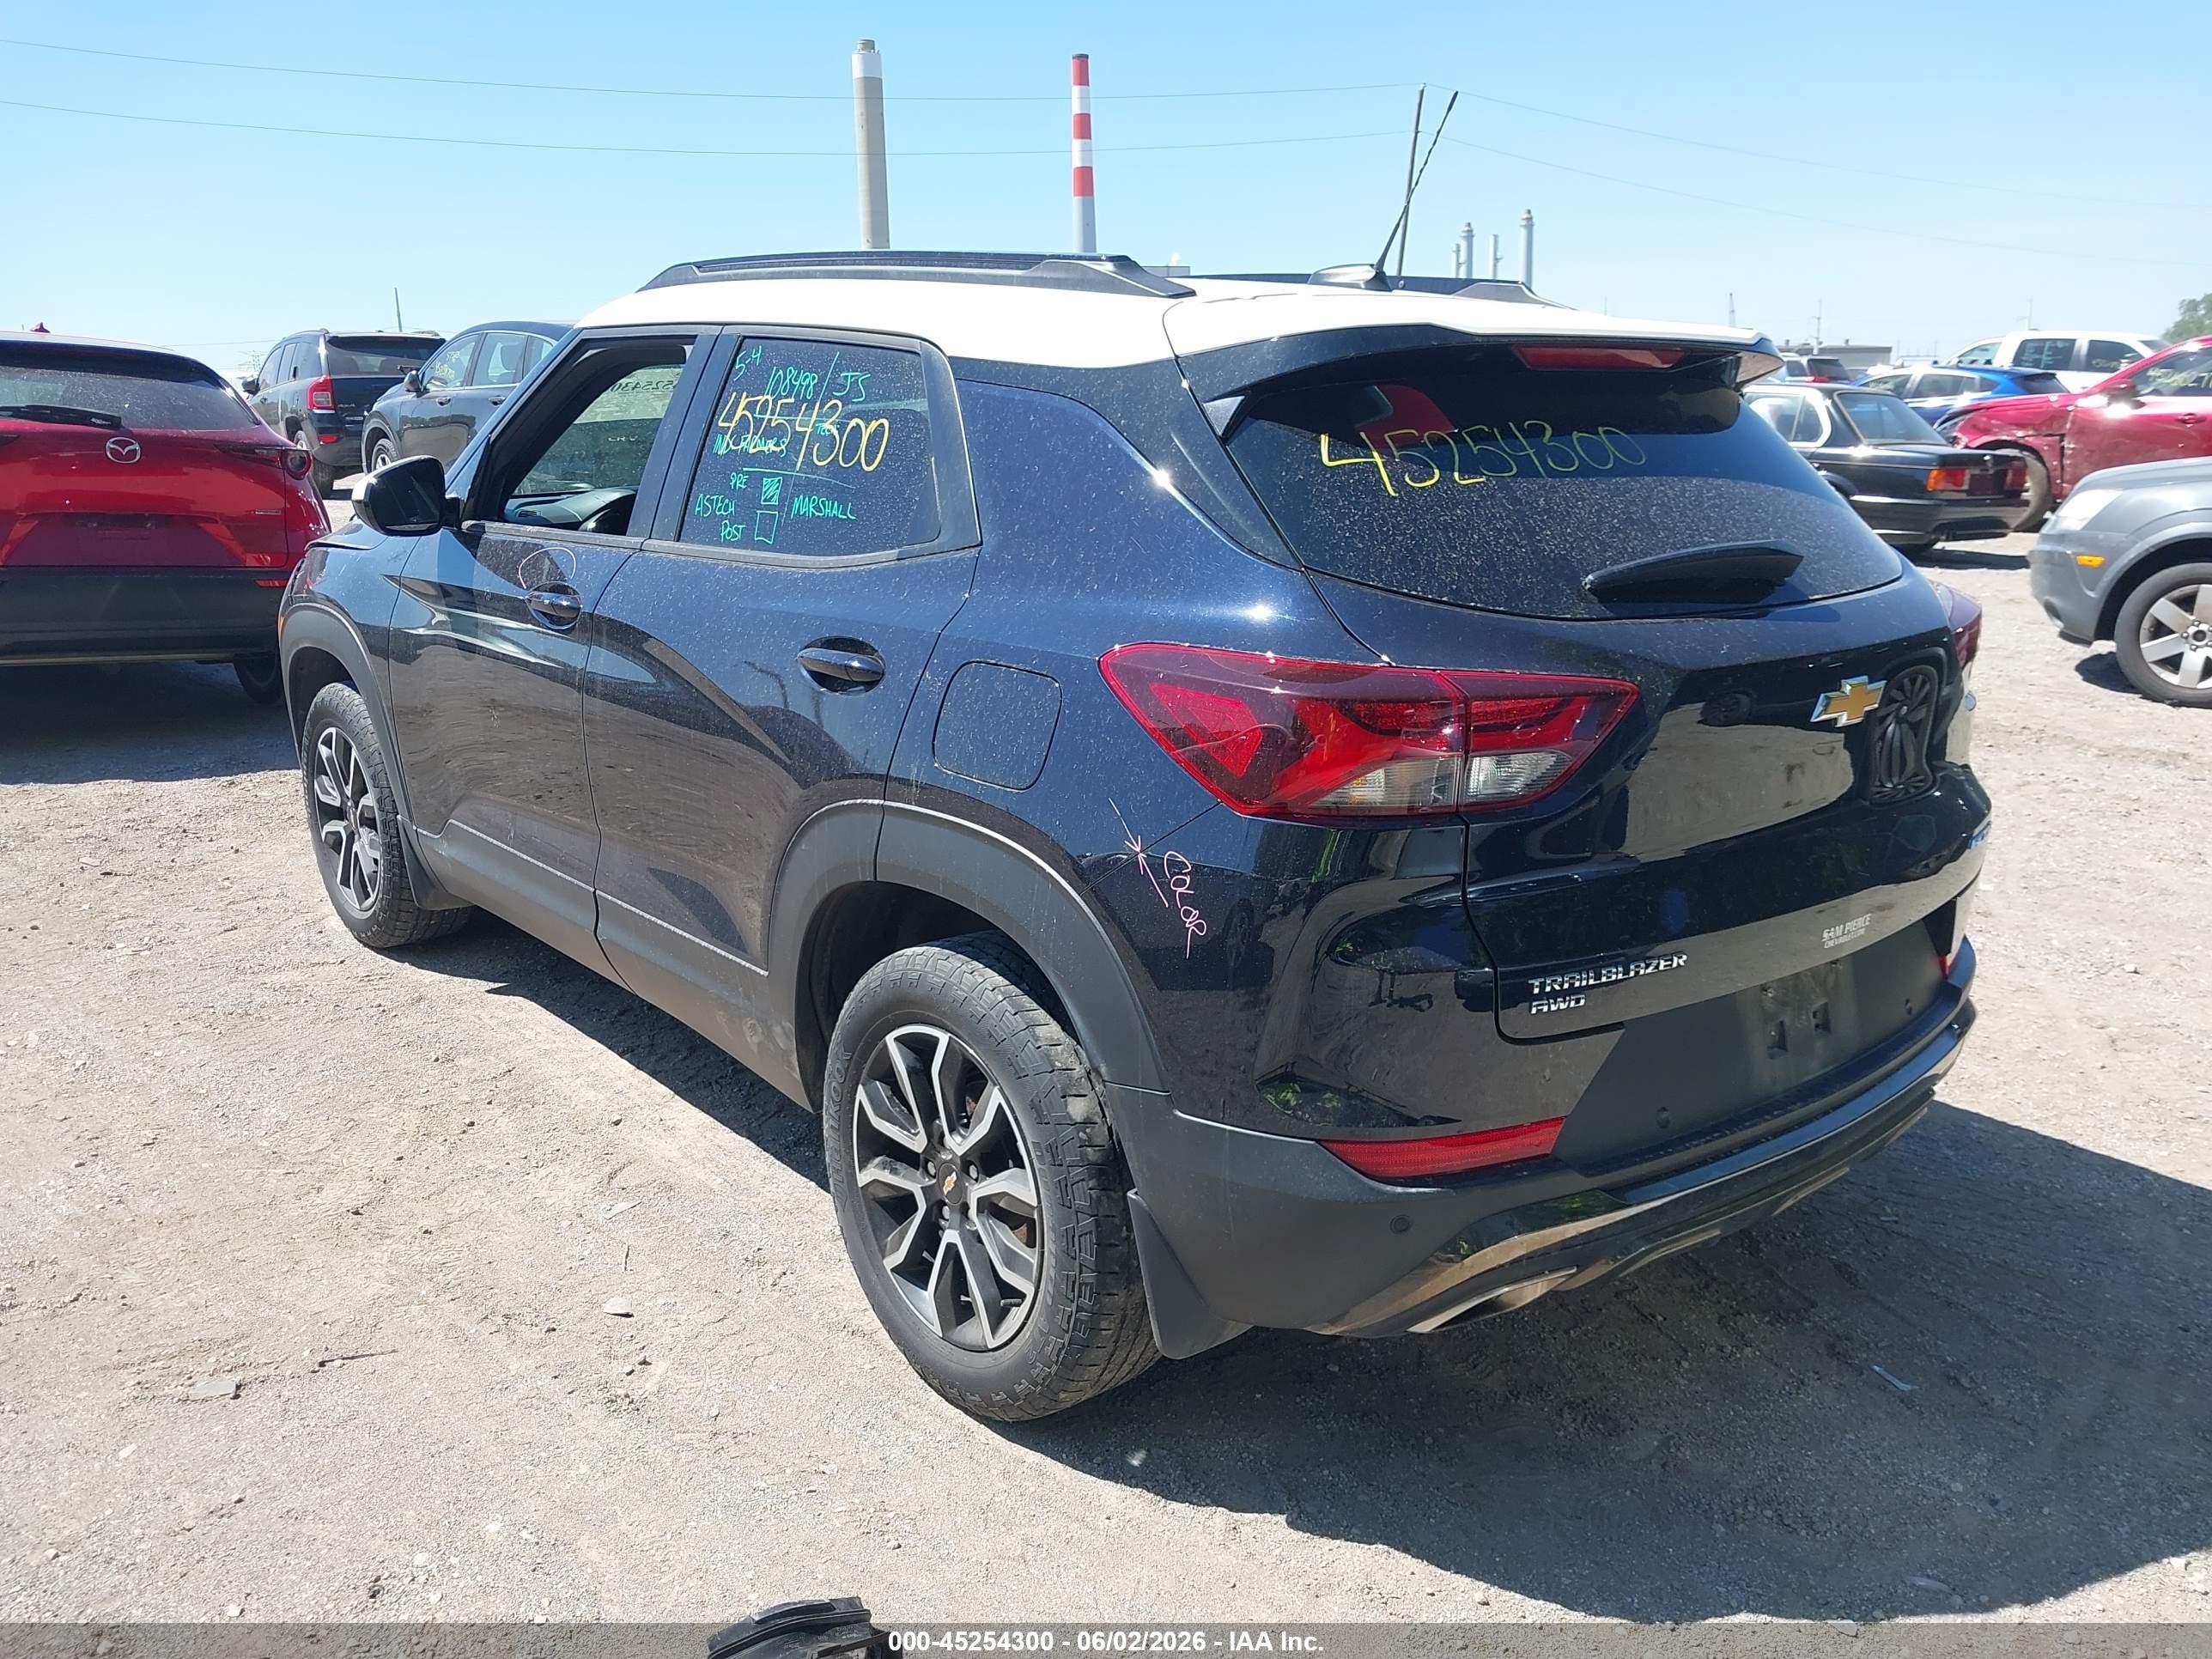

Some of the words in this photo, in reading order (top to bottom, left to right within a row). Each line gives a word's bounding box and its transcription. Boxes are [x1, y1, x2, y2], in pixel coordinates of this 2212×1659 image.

[1321, 420, 1646, 496] 45254300
[730, 472, 749, 490] PRE
[695, 493, 736, 518] ASTECH
[790, 495, 858, 520] MARSHALL
[720, 519, 746, 543] POST
[1528, 953, 1688, 994] TRAILBLAZER
[1531, 994, 1586, 1015] AWD
